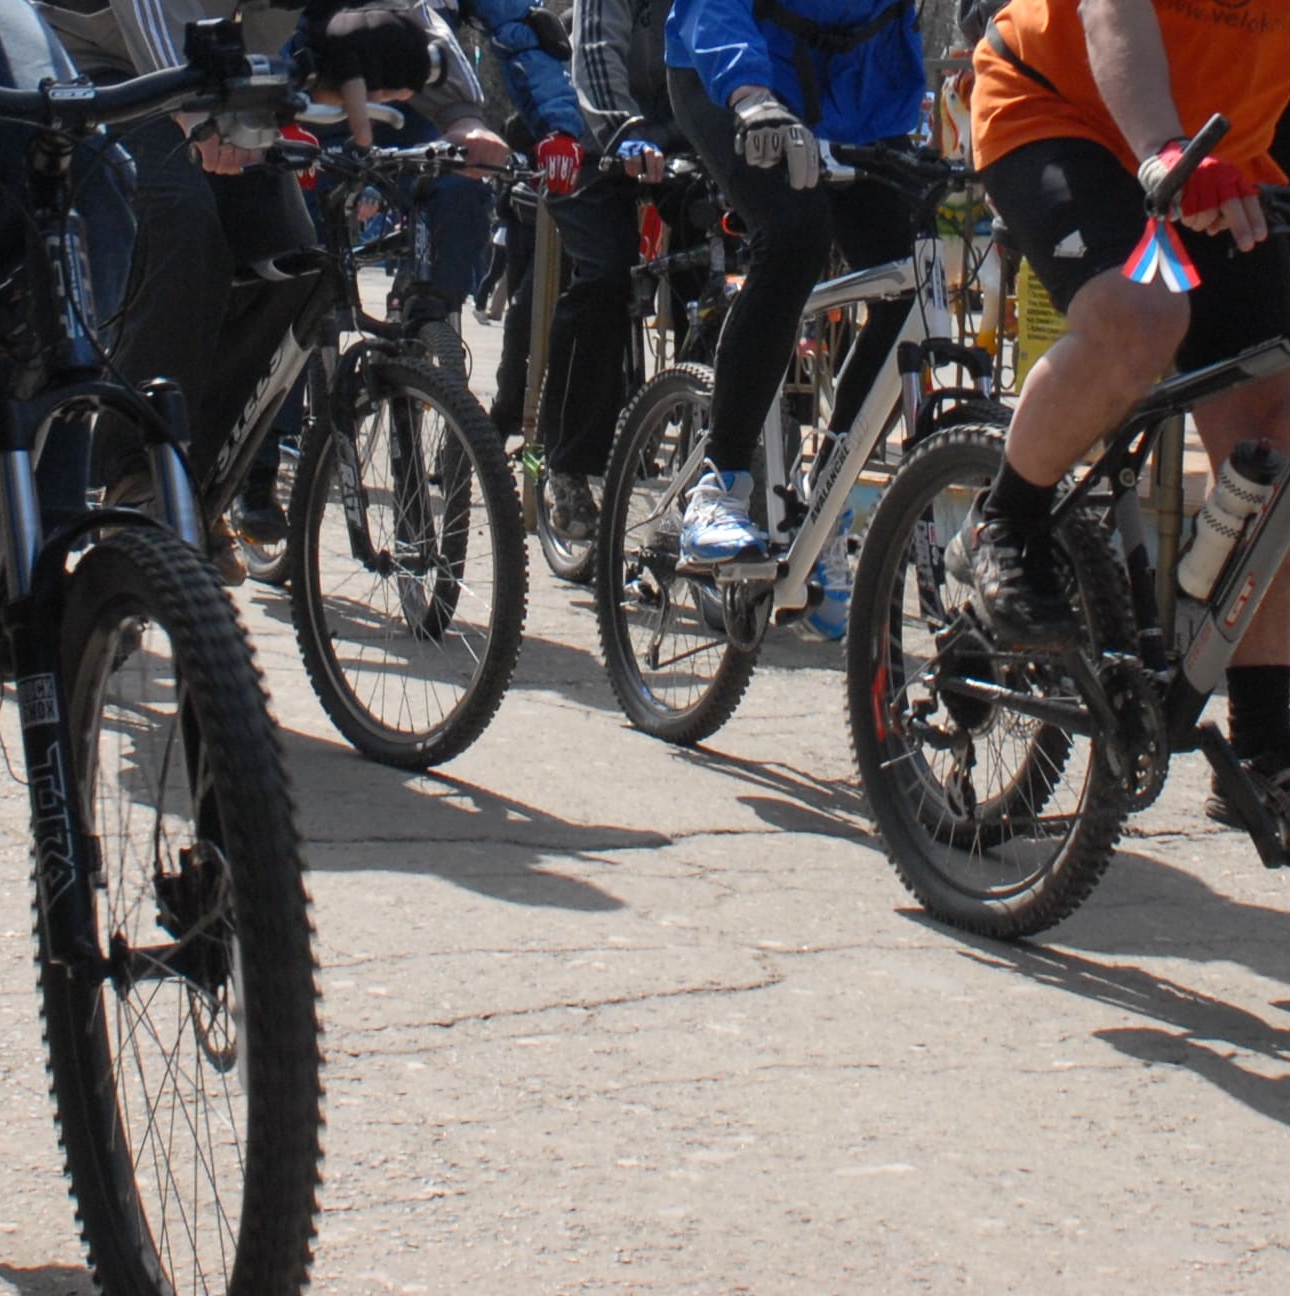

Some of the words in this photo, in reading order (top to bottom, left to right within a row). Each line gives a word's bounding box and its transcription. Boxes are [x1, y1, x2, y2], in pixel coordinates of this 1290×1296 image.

[216, 346, 284, 474] STELS
[811, 436, 851, 525] AVALANCHE
[30, 741, 77, 914] TORA
